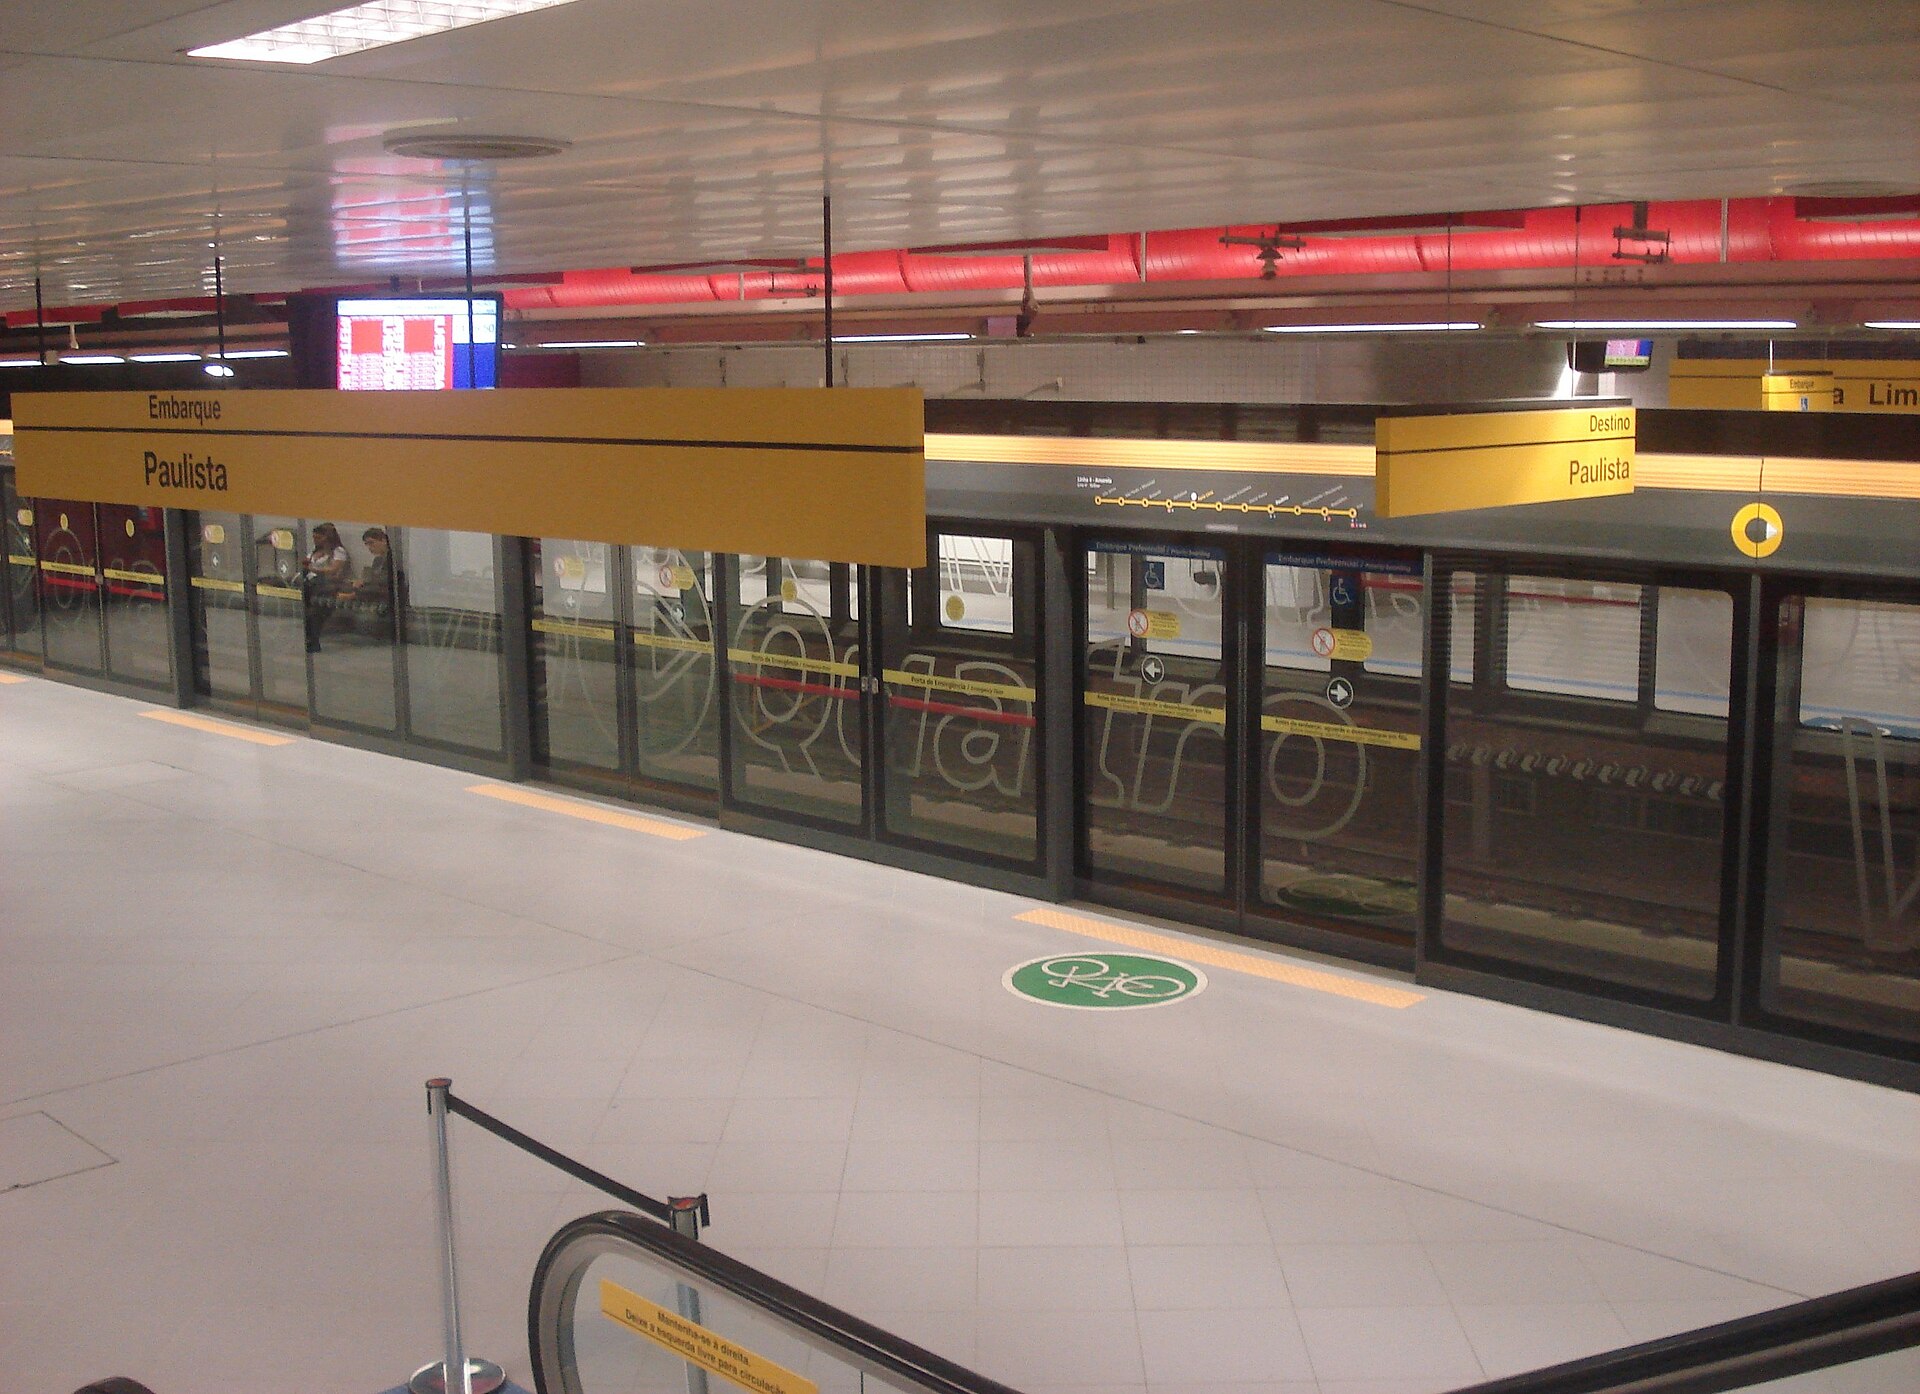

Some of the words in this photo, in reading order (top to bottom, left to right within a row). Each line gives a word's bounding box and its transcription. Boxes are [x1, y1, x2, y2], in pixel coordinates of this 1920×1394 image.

[1870, 383, 1920, 406] Lim
[149, 394, 222, 426] Embarque
[1590, 413, 1631, 432] Destino
[144, 451, 228, 491] Paulista
[1569, 457, 1630, 485] Paulista
[697, 1346, 716, 1364] livre
